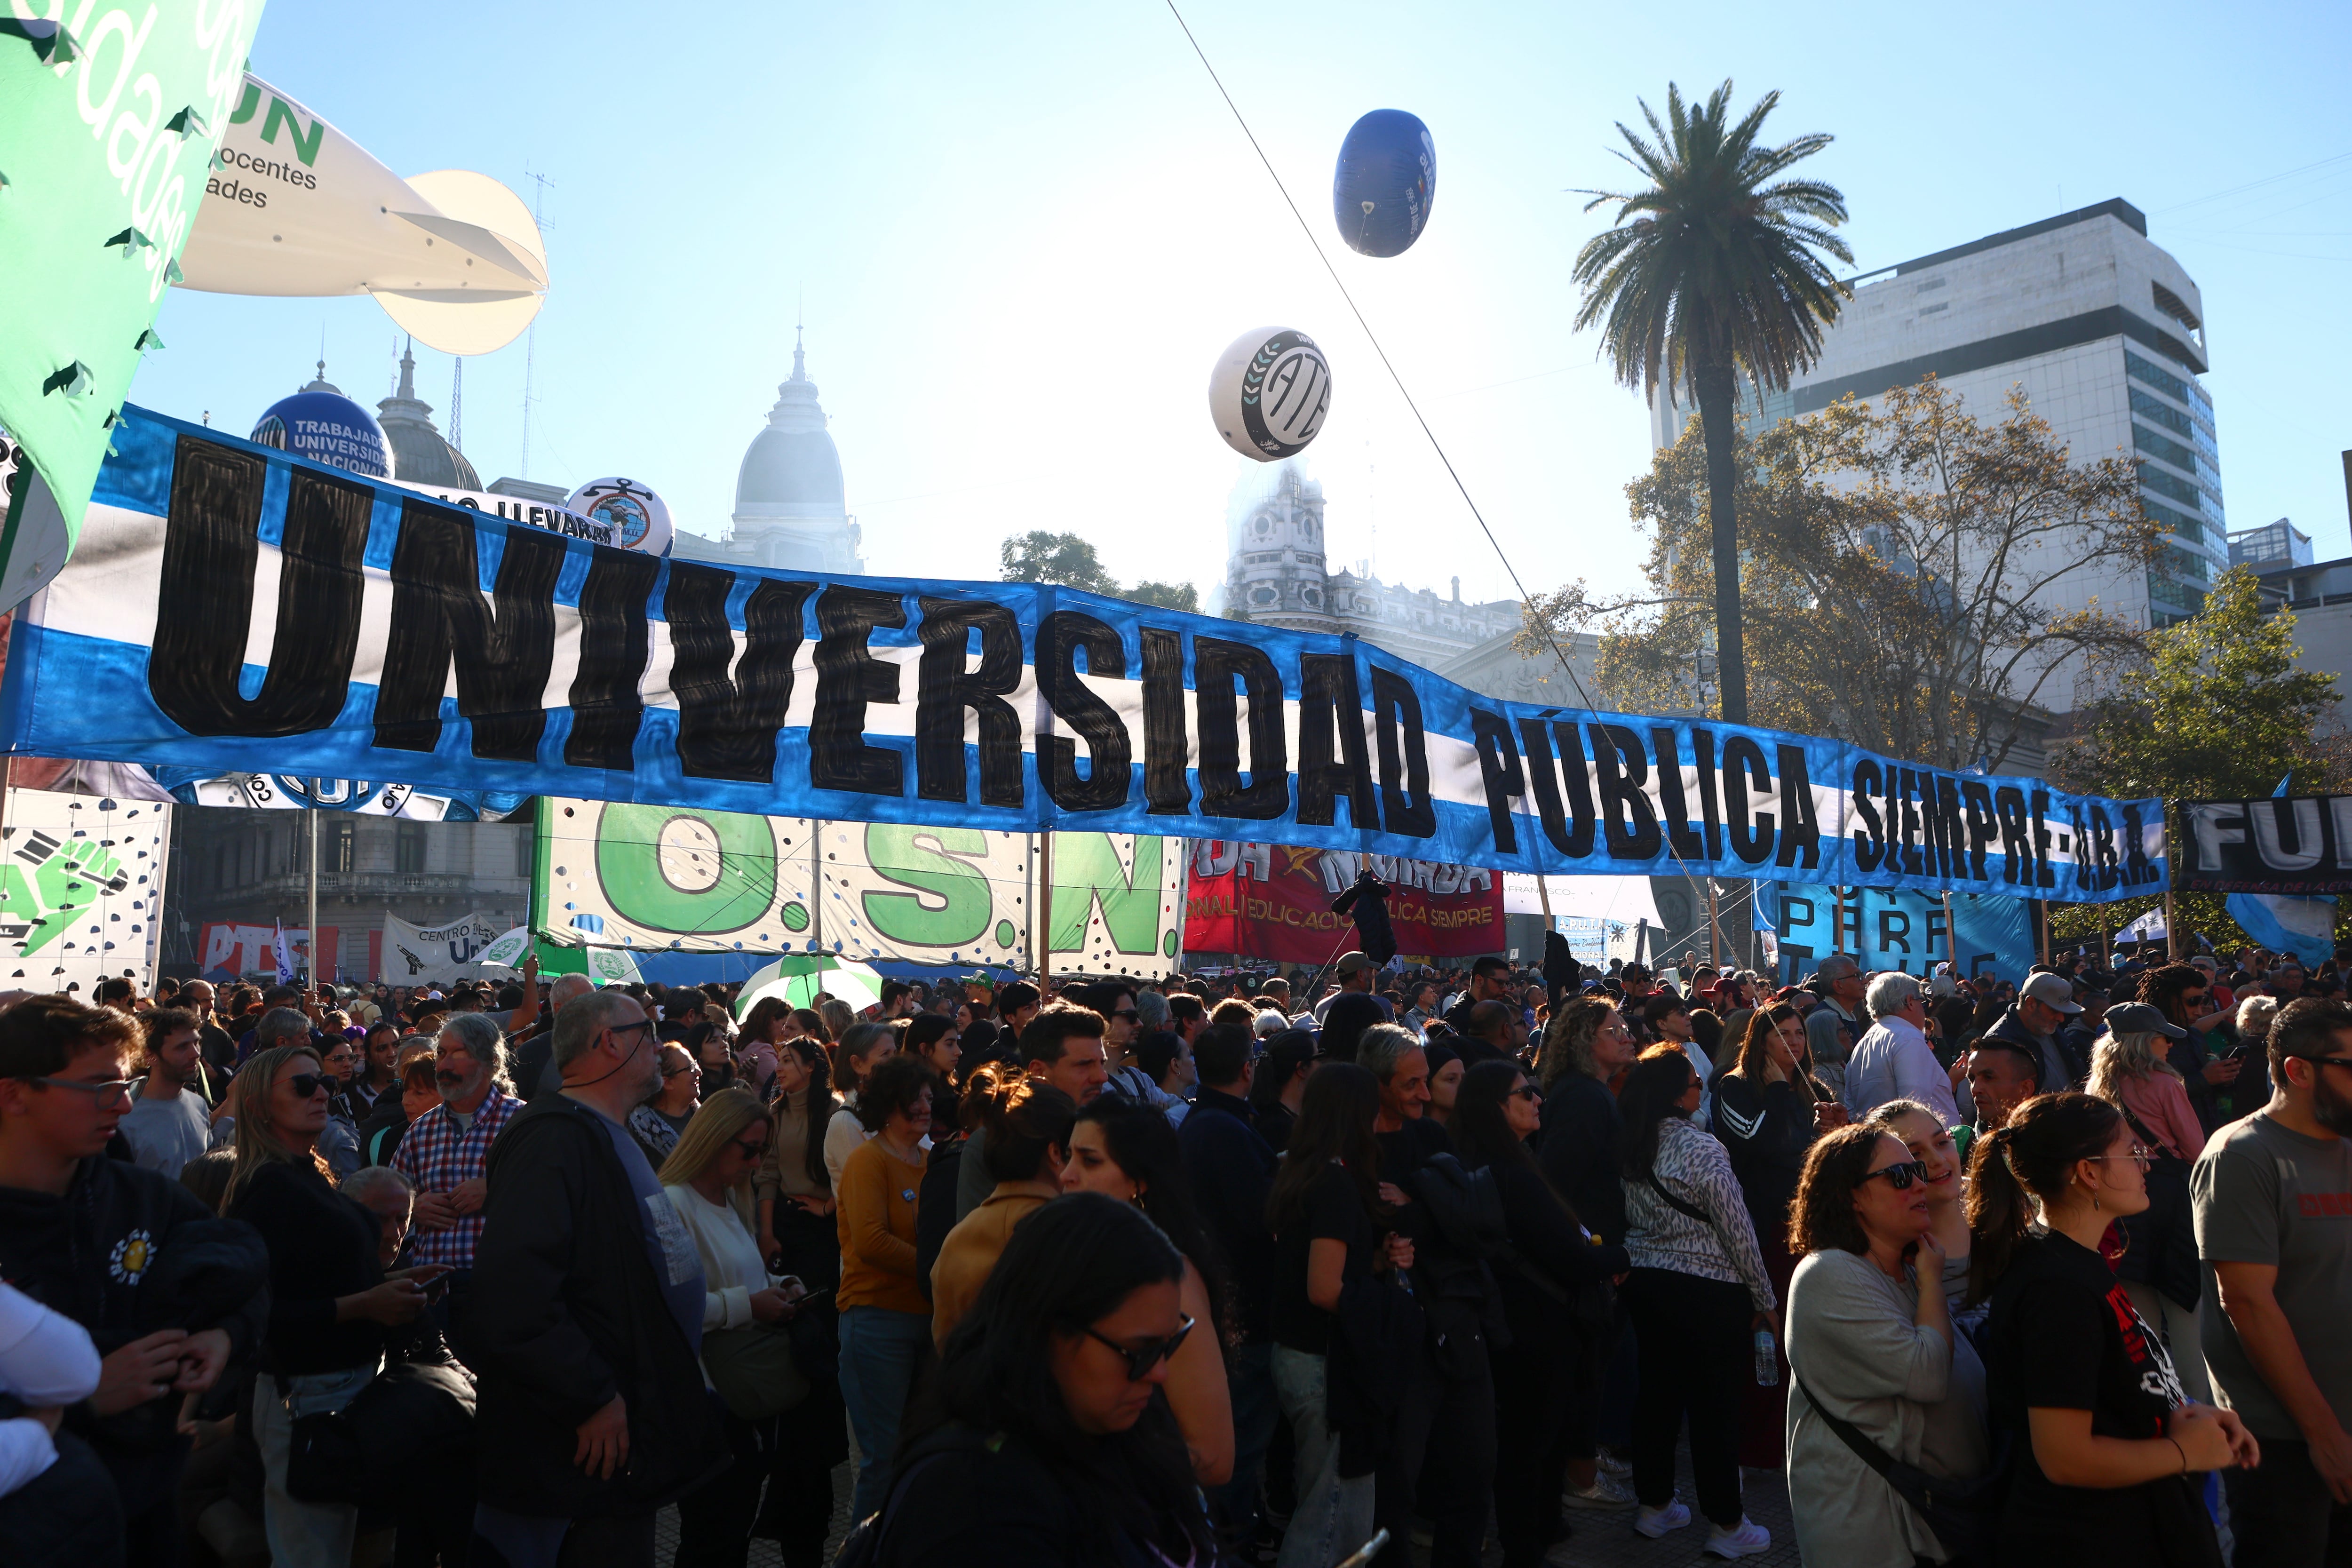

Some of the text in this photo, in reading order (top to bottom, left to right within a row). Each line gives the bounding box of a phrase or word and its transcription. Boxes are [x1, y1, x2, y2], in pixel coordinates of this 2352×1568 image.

[148, 433, 1437, 839] UNIVERSIDAD
[1469, 705, 1820, 870] PÚBLICA
[419, 925, 469, 941] CENTRO
[1430, 906, 1493, 928] SIEMPRE
[203, 923, 310, 974] PTS
